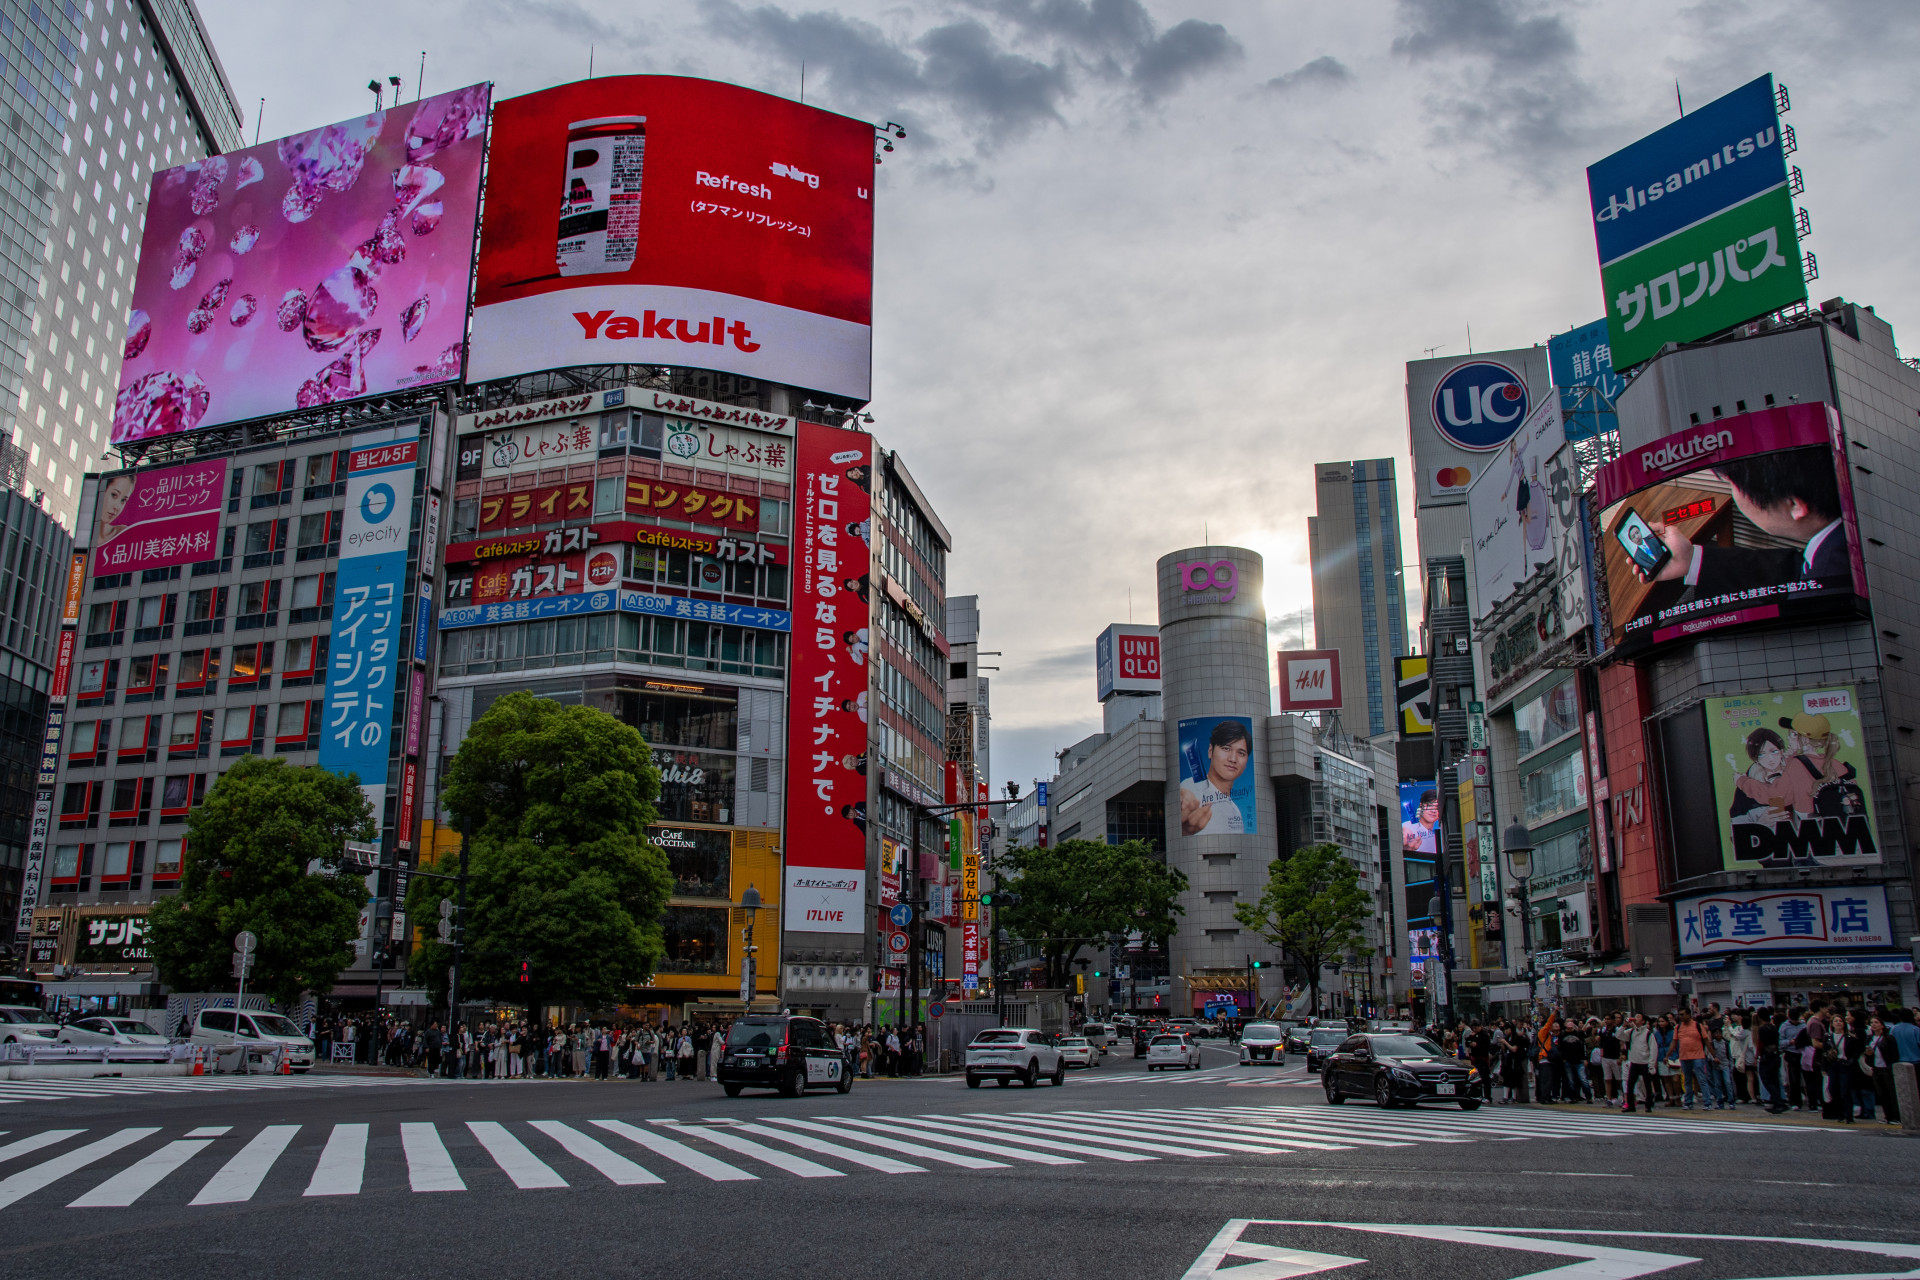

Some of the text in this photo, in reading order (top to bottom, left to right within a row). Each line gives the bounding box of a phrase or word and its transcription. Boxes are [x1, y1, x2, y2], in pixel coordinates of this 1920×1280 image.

[695, 170, 772, 201] Refresh
[1596, 125, 1776, 223] Hisamitsu
[1615, 225, 1788, 333] サロンパス
[572, 309, 761, 353] Yakult
[1571, 344, 1614, 380] 龍角
[473, 394, 593, 429] しゃぶしゃぶバイキング
[653, 393, 789, 430] しゃぶしゃぶバイキング
[1442, 382, 1522, 427] UC
[1535, 415, 1555, 440] CHANEL
[522, 425, 593, 459] しゃぶ葉
[707, 433, 787, 469] しゃぶ葉
[1641, 429, 1735, 473] Rakuten
[355, 445, 411, 469] 当ビル5F
[461, 449, 482, 467] 9F
[156, 470, 220, 494] 品川スキン
[154, 488, 211, 512] クリニック
[482, 485, 591, 524] プライス
[626, 480, 758, 522] コンタクト
[1665, 499, 1714, 523] ニセ警官
[111, 530, 211, 565] 品川美容外科
[348, 527, 402, 548] eyecity
[542, 526, 599, 556] ガスト
[1551, 456, 1586, 624] もんじゃ
[715, 537, 776, 566] ガスト
[478, 572, 508, 590] Café
[509, 562, 579, 598] ガスト
[590, 566, 615, 577] ガスト
[1177, 560, 1239, 603] 109
[67, 564, 83, 617] 東京スター銀行
[448, 578, 473, 599] 7F
[592, 592, 608, 608] 6F
[485, 597, 586, 622] 英会話イーオン
[626, 593, 666, 612] AEON
[675, 600, 787, 626] 英会話イーオン
[443, 608, 477, 625] AEON
[1682, 613, 1738, 634] Rakuten Vision
[1099, 633, 1110, 656] THE
[1123, 640, 1155, 656] UNI
[1097, 659, 1113, 692] PRIME
[1124, 658, 1158, 675] QLO
[1295, 669, 1326, 690] H&M
[1723, 699, 1763, 708] 山田くんと
[42, 711, 62, 771] 加藤眼科
[40, 773, 54, 782] 5F
[405, 764, 415, 806] 外貨両替
[37, 792, 51, 801] 3F
[1202, 786, 1253, 804] Are You Ready?
[33, 817, 47, 838] 内科
[1731, 815, 1879, 861] DMM
[49, 920, 61, 931] 2F
[806, 909, 844, 922] 17LIVE
[1683, 898, 1871, 943] 大盛堂書店
[32, 938, 58, 949] 処方せん
[926, 928, 943, 952] LUSH
[964, 925, 978, 972] スギ薬局
[37, 950, 51, 961] 受付
